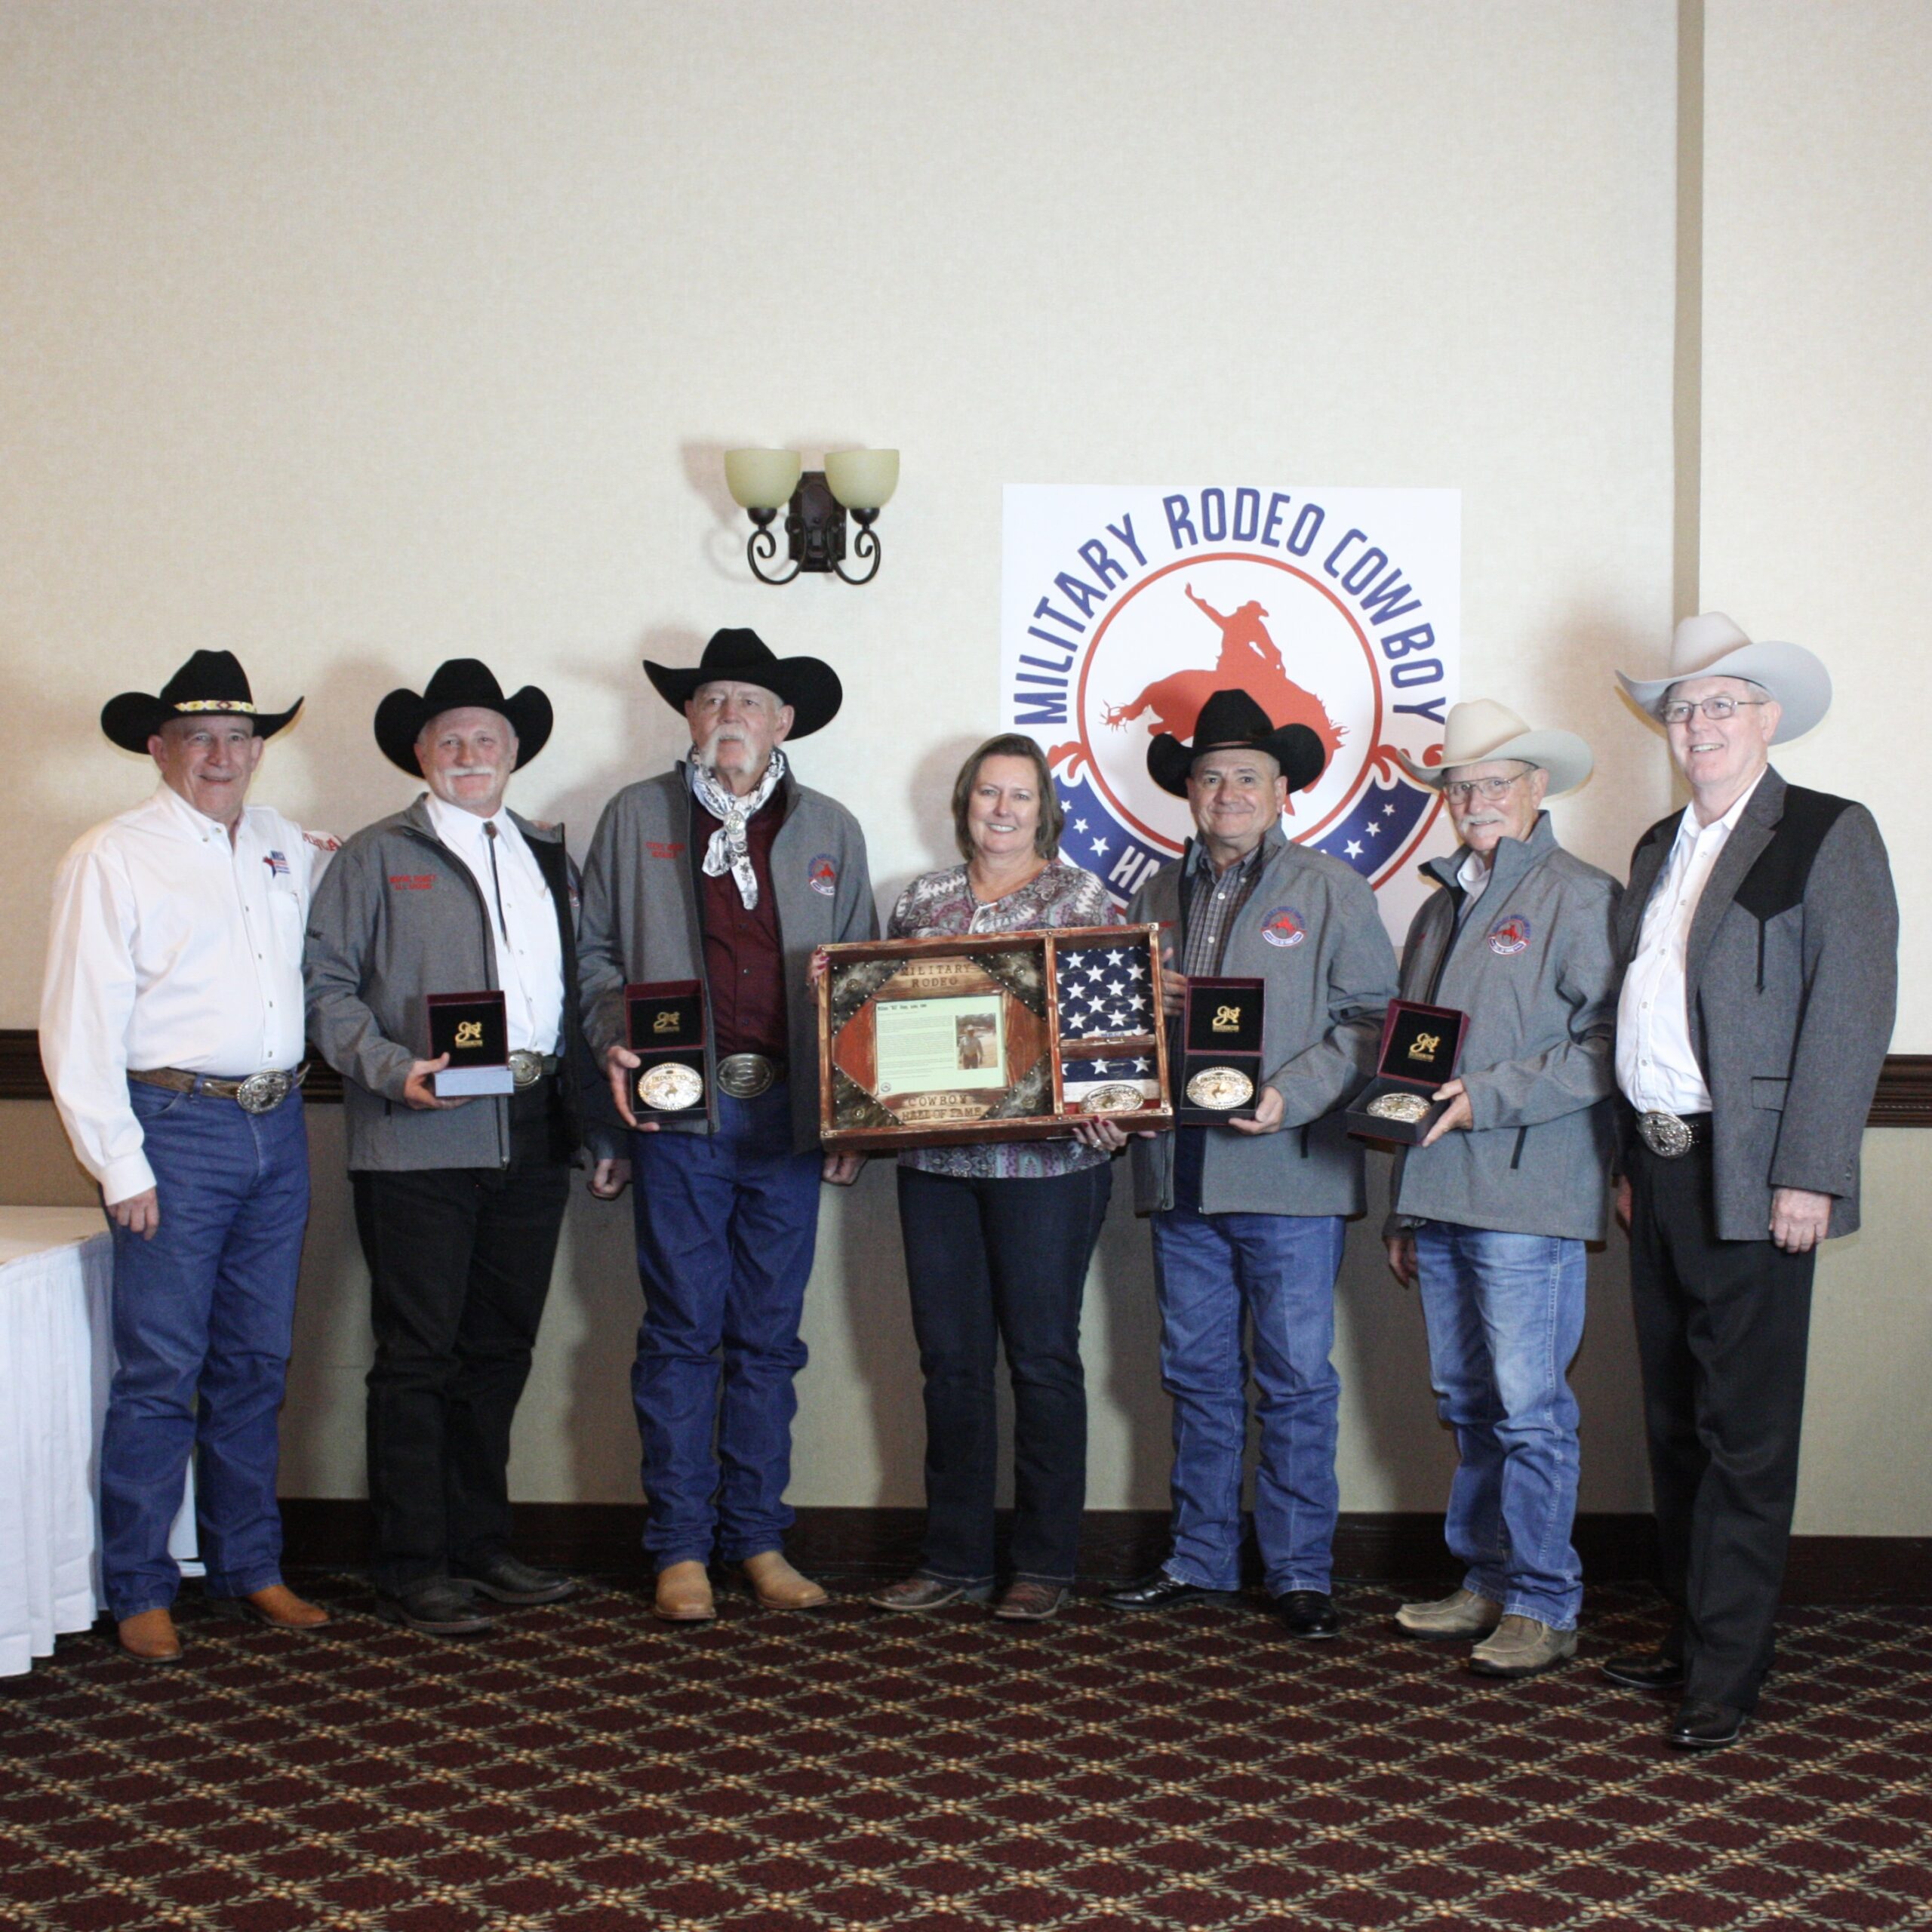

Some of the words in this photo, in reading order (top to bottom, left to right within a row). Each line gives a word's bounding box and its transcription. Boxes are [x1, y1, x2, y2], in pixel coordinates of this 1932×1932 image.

[1014, 513, 1148, 724] MILITARY
[1163, 487, 1326, 558] RODEO
[1323, 528, 1446, 725] COWBOY
[1108, 844, 1161, 895] HA
[900, 963, 971, 977] MILITARY
[911, 977, 958, 989] RODEO
[908, 1093, 968, 1107] COWBOY
[902, 1109, 931, 1121] HALL
[932, 1109, 948, 1119] OF
[949, 1106, 982, 1118] FAME
